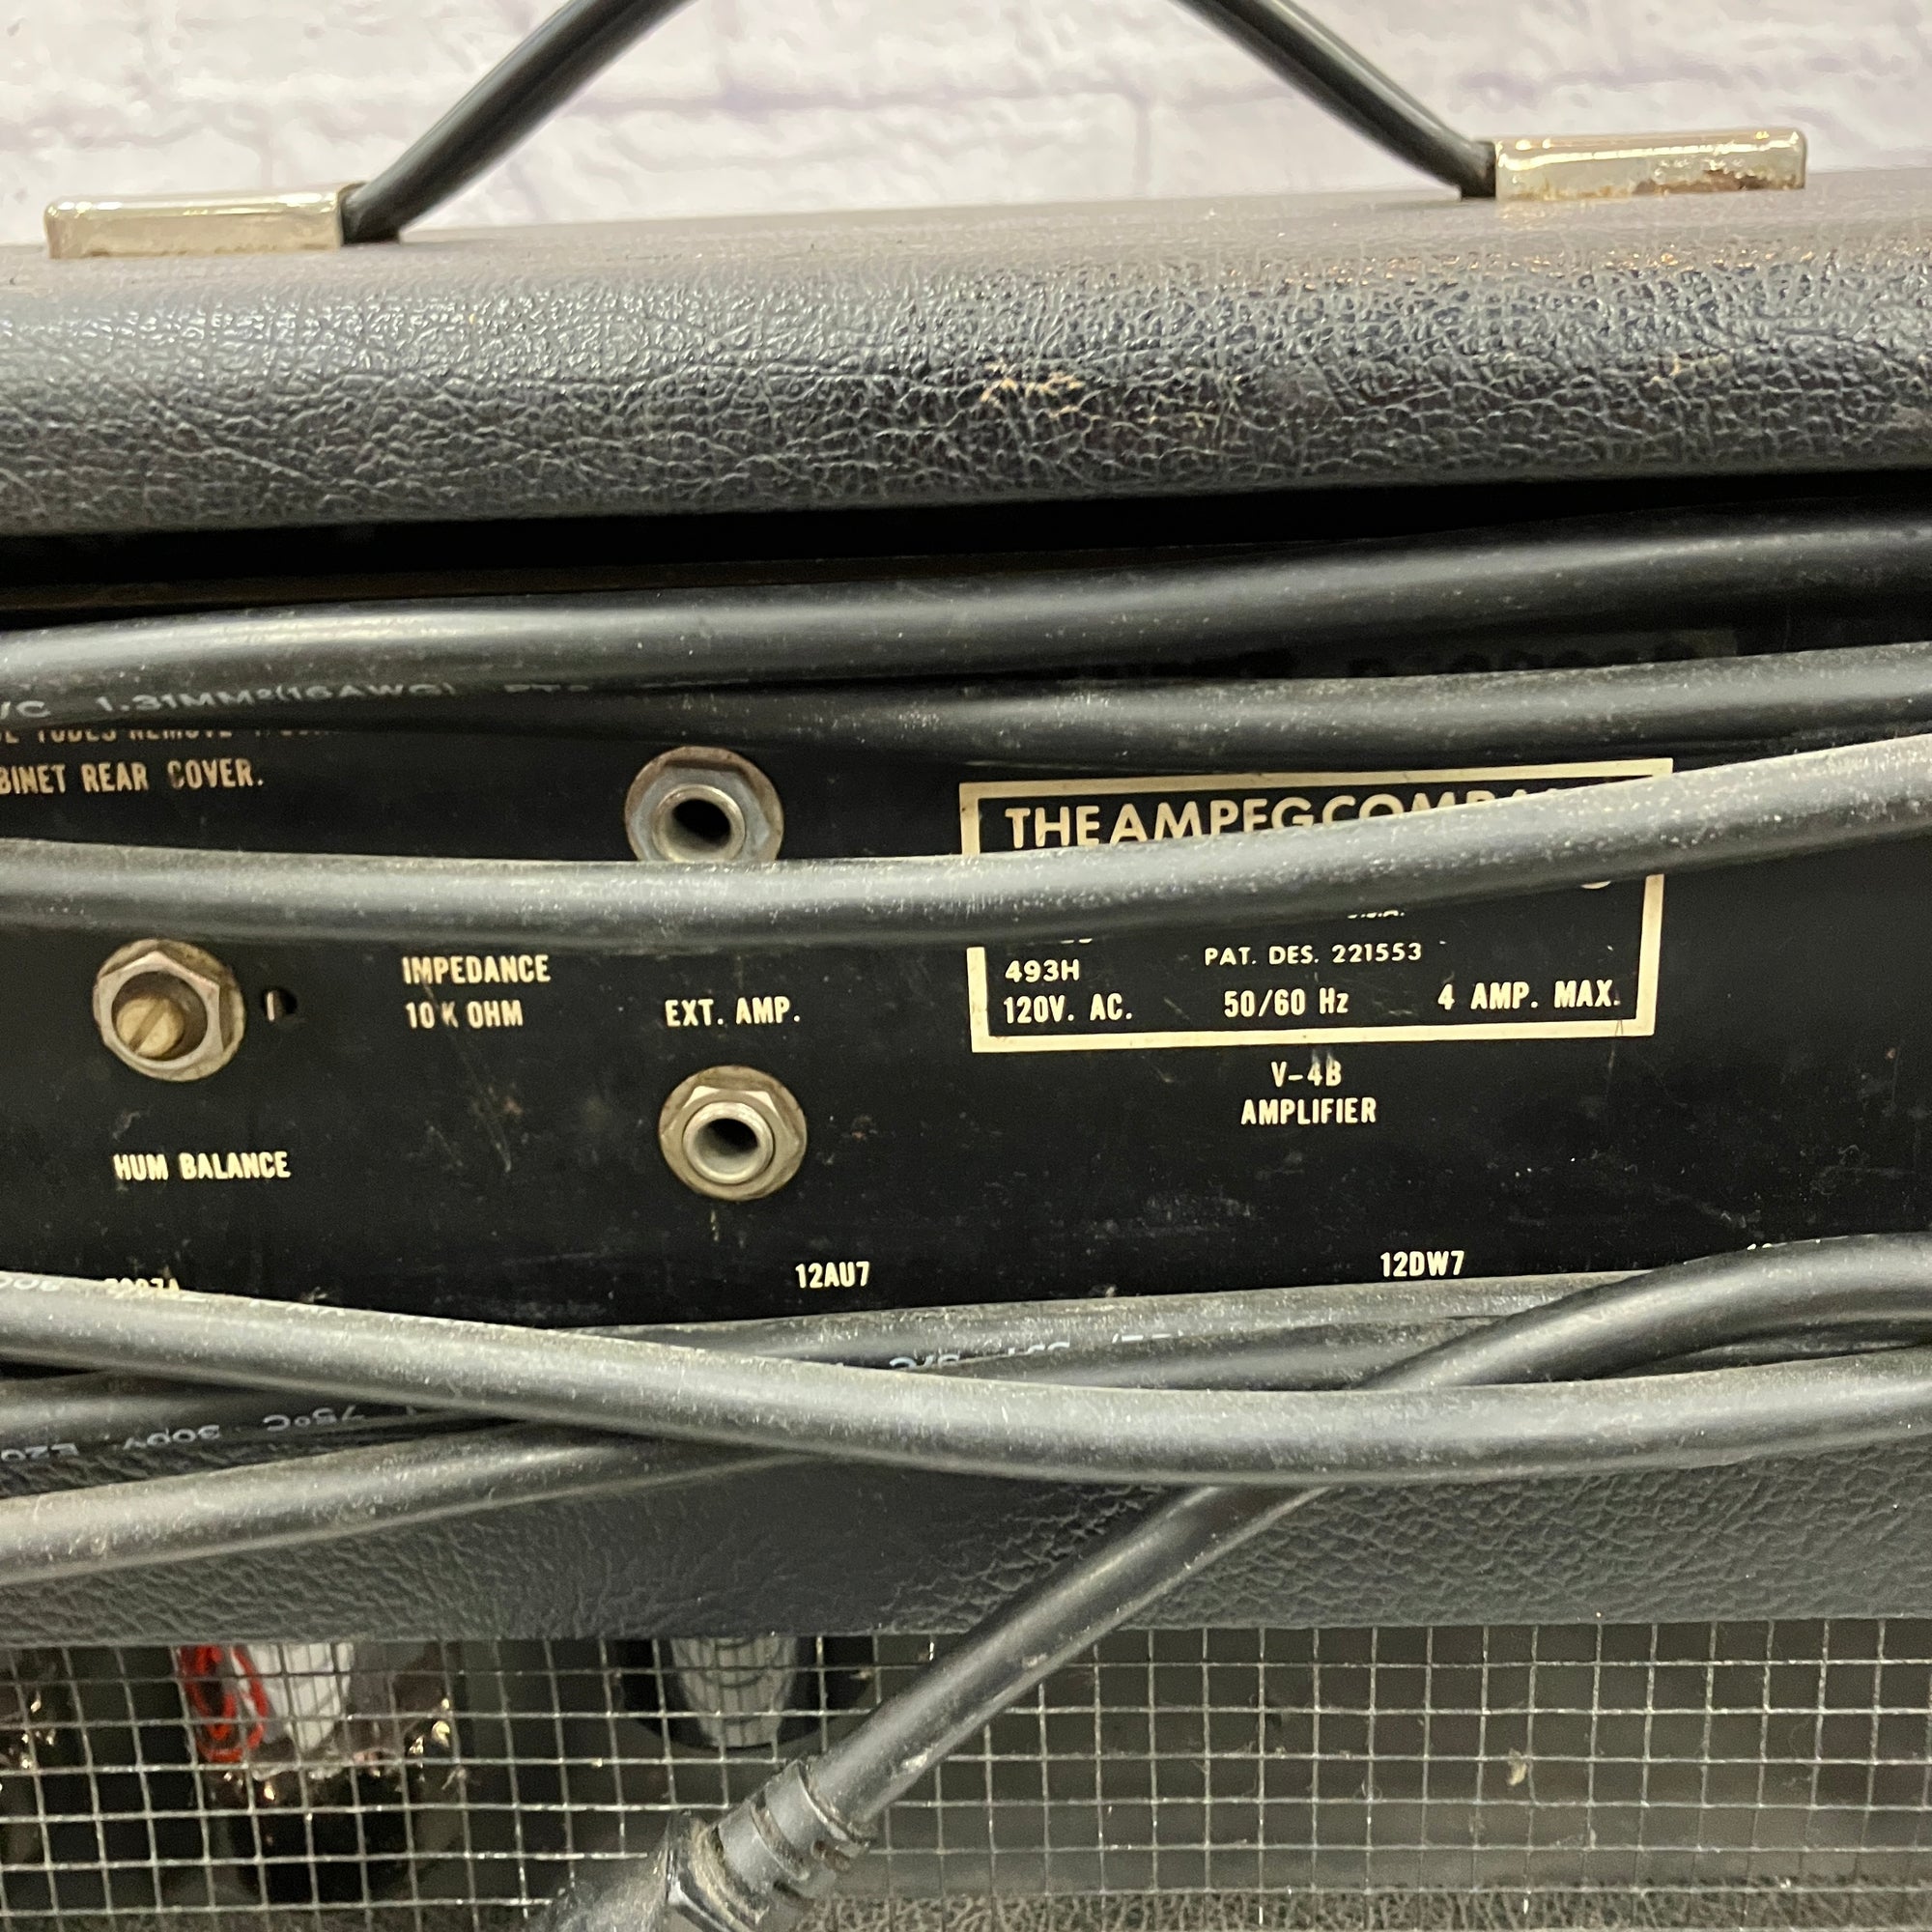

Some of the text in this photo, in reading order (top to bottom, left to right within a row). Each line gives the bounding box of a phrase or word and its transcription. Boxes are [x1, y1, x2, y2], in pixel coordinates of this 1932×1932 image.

[81, 762, 148, 792] REAR
[167, 758, 264, 789] COVER.
[1005, 805, 1100, 849] THE
[401, 953, 552, 984] IMPEDANCE
[1205, 942, 1422, 966] PAT. DES. 221553
[1005, 958, 1080, 983] 493H
[1003, 992, 1133, 1024] 120V. AC.
[1224, 986, 1350, 1018] 50/60 Hz
[1437, 979, 1621, 1010] 4 AMP. MAX.
[466, 999, 524, 1029] OHM
[665, 995, 801, 1028] EXT. AMP.
[1270, 1060, 1342, 1088] V-4B
[1240, 1096, 1377, 1125] AMPLIFIER
[112, 1151, 292, 1181] HUM BALANCE
[795, 1261, 870, 1289] 12AU7
[1379, 1250, 1465, 1280] 12DW7
